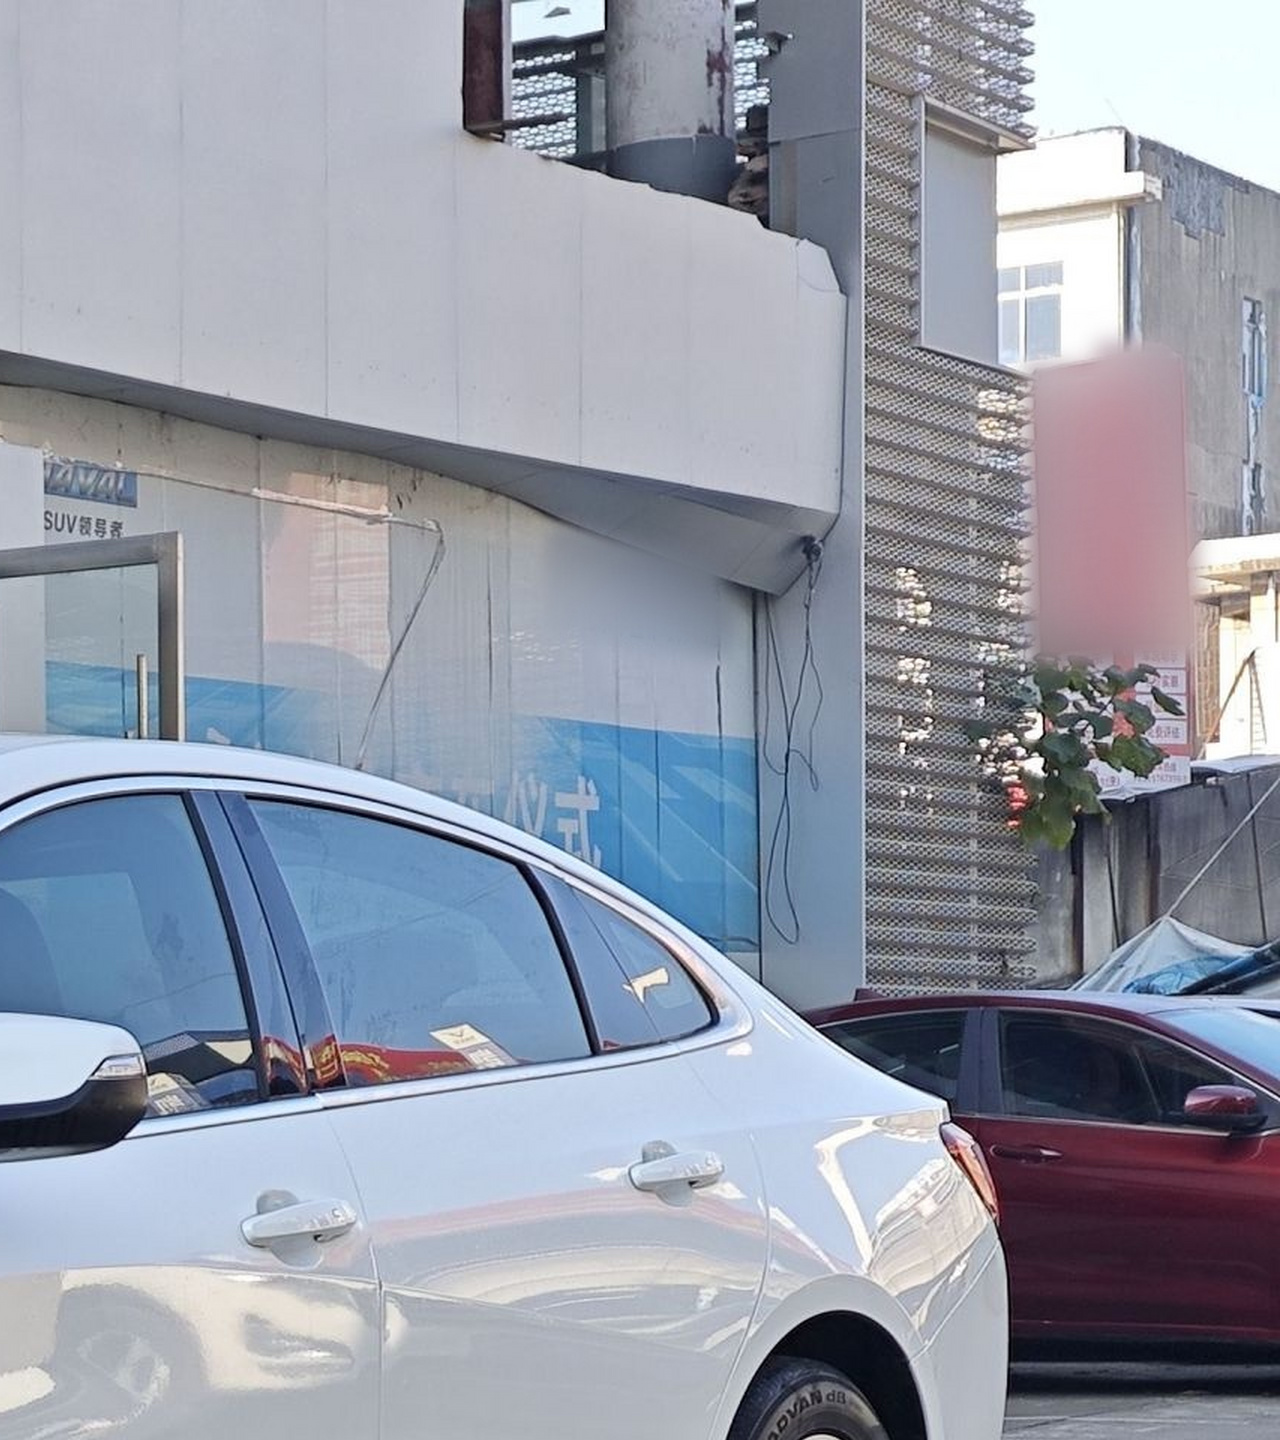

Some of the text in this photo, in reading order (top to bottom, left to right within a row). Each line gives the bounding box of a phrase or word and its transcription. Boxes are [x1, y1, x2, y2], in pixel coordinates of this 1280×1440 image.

[43, 509, 123, 539] SUV领导者
[826, 1389, 847, 1405] dB
